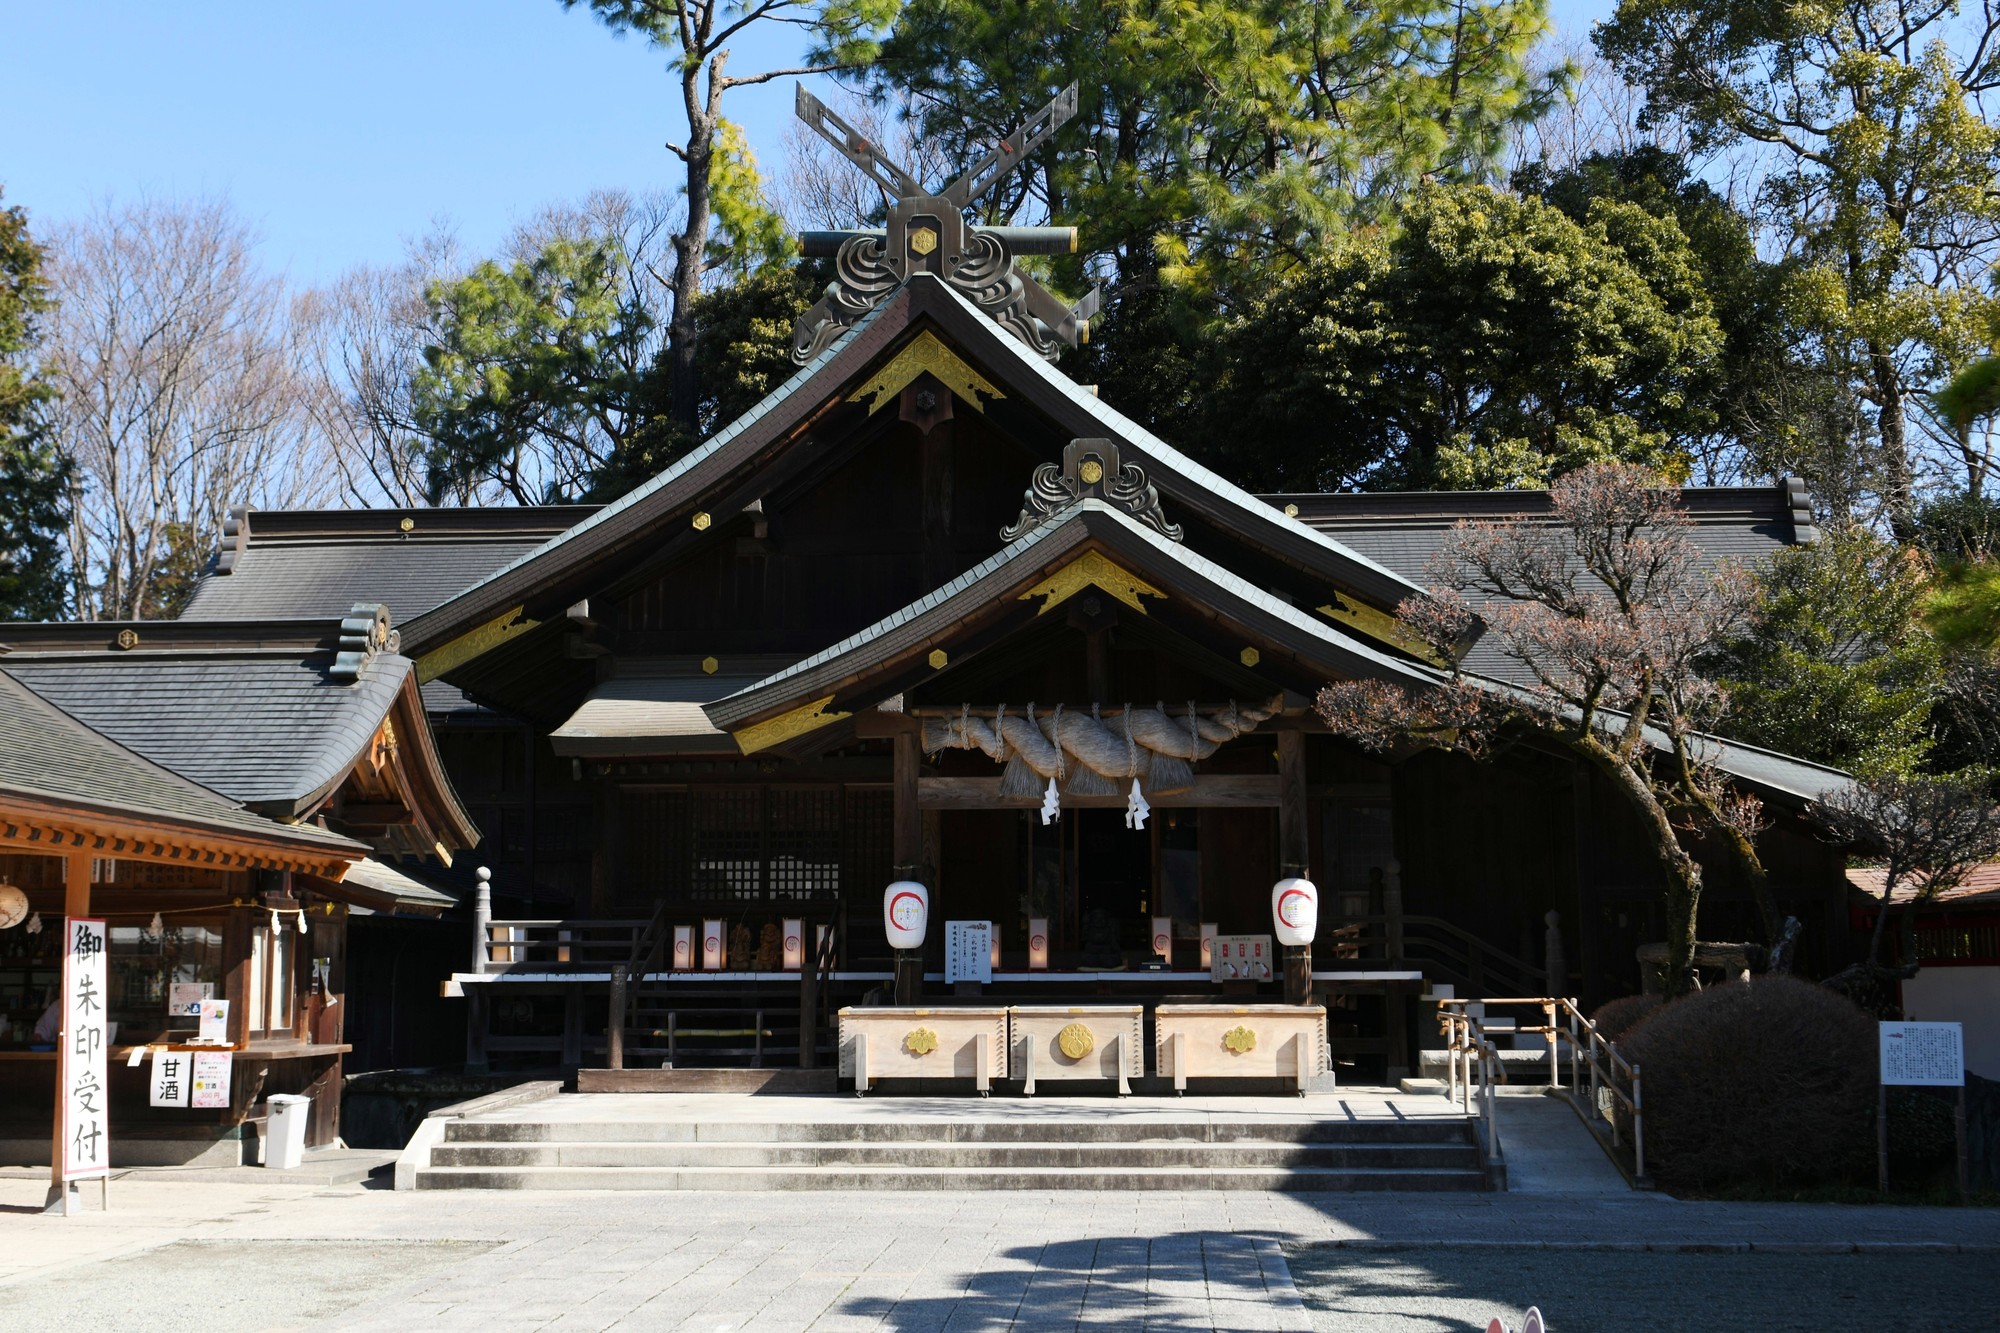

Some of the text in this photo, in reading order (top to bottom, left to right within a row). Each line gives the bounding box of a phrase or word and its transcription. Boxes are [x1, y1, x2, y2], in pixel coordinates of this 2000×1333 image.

[73, 924, 102, 1163] 御朱印受付
[159, 1058, 181, 1101] 甘酒
